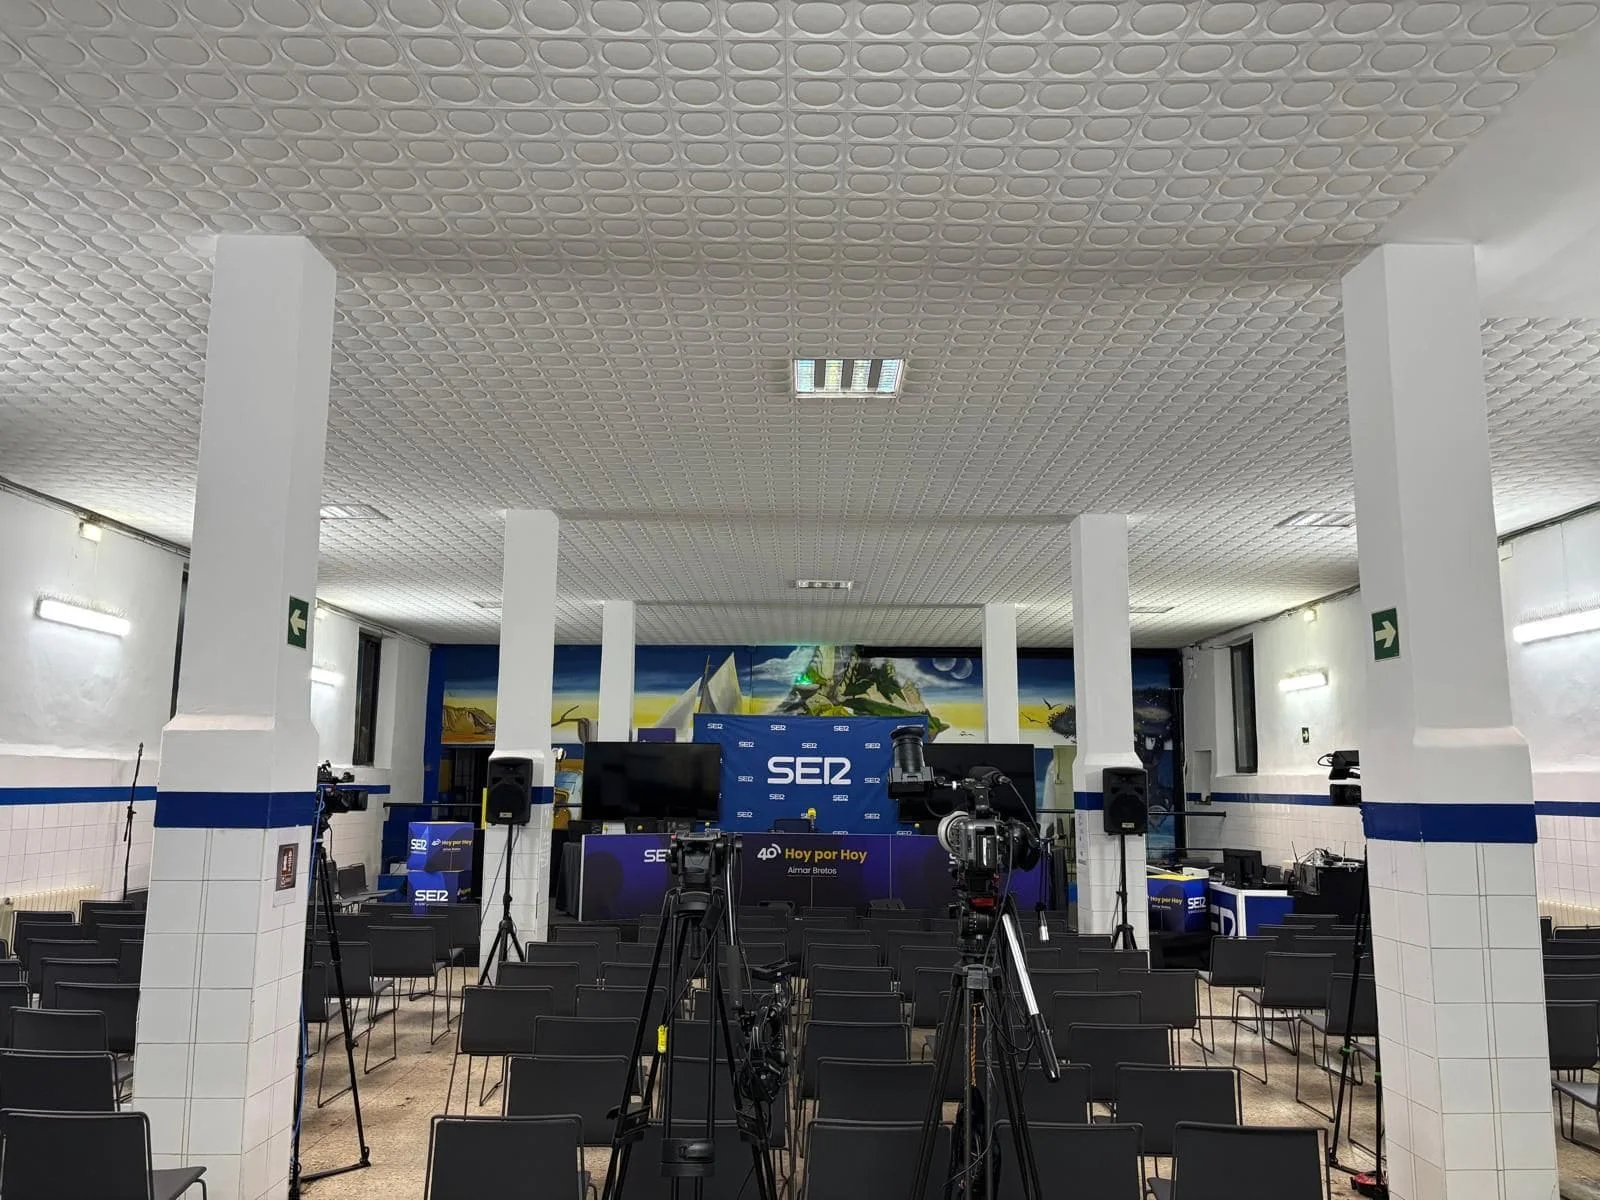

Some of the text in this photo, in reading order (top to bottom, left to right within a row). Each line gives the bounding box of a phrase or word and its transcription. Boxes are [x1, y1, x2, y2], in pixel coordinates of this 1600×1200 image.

[707, 722, 723, 730] SER
[767, 756, 852, 785] SER
[410, 838, 427, 850] SER
[643, 849, 671, 862] SE
[784, 848, 812, 862] Hoy
[814, 850, 838, 863] por
[840, 849, 868, 864] Hoy
[787, 866, 837, 875] Aimar Bretos
[414, 889, 449, 902] SER
[1187, 896, 1207, 909] SER
